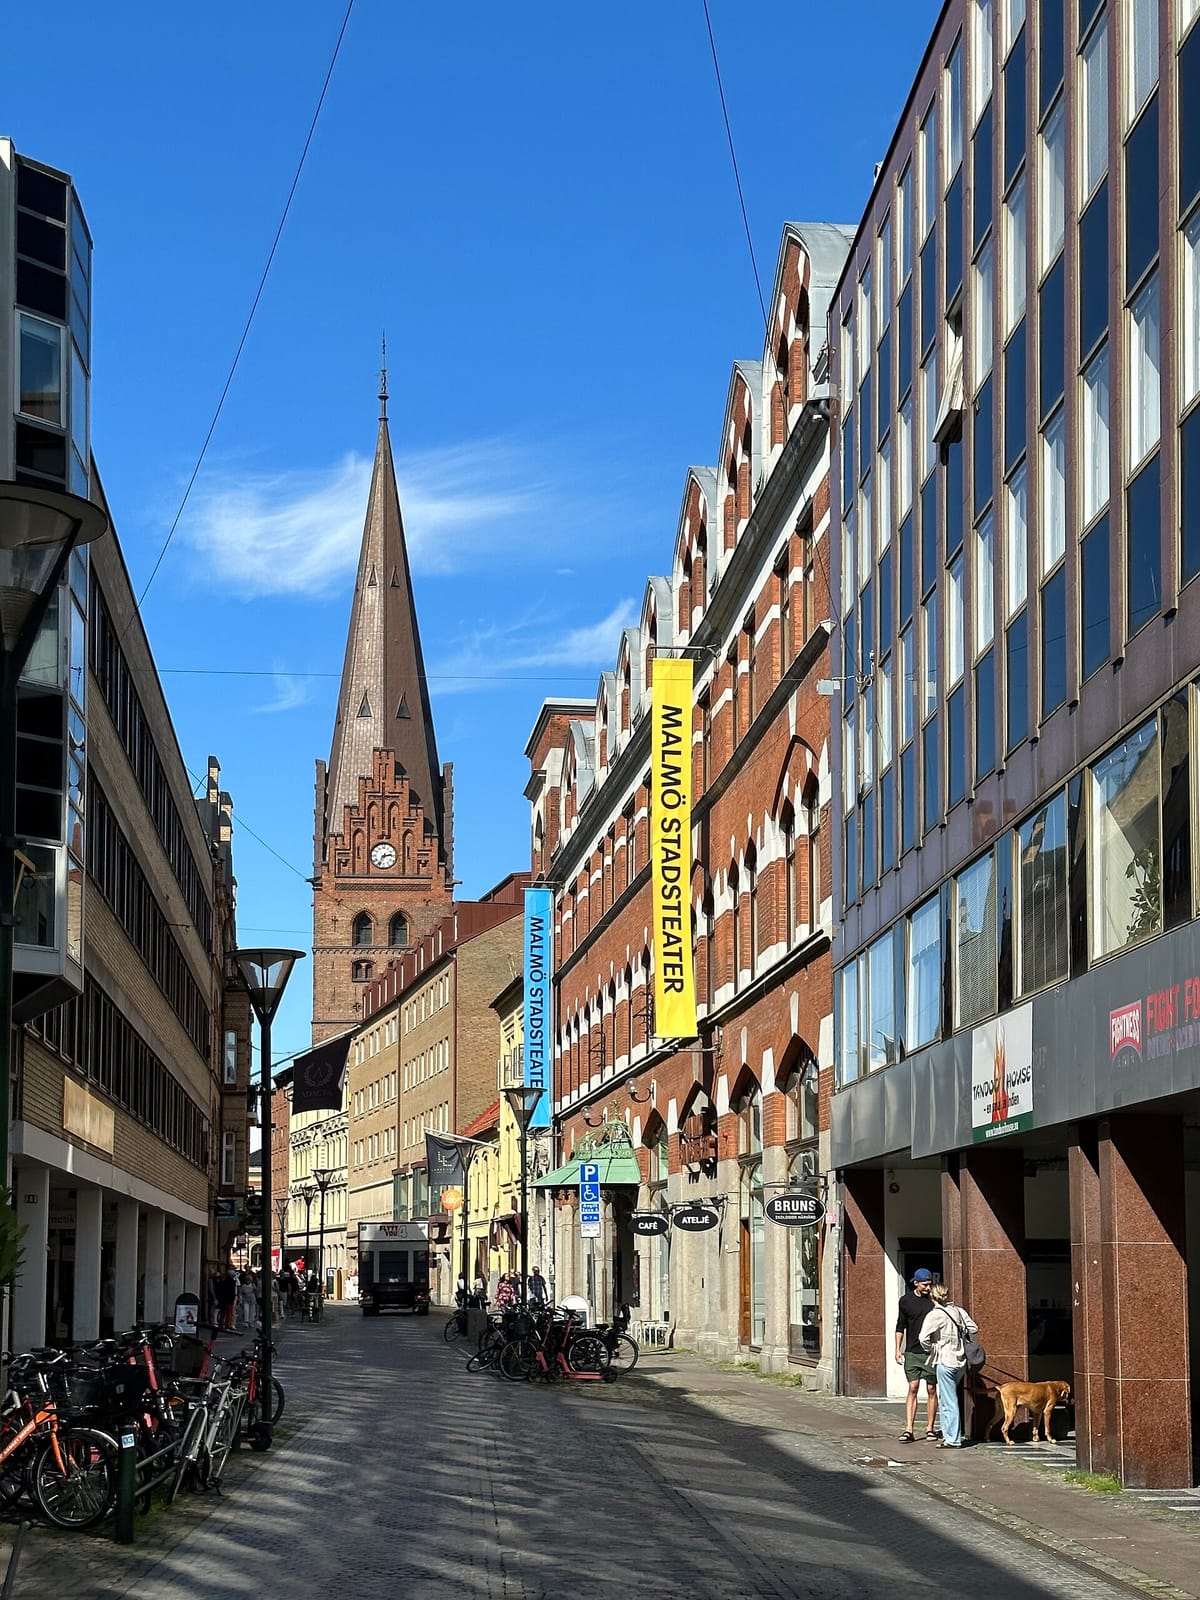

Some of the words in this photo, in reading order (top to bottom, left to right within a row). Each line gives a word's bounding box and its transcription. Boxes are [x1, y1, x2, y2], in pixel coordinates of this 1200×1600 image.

[661, 705, 686, 809] MALMÖ
[661, 817, 684, 994] STADSTEATER
[530, 917, 546, 983] MALMÖ
[1111, 1008, 1140, 1053] FIGHTNESS
[1146, 984, 1180, 1036] FIGHT
[530, 987, 544, 1088] STADSTEATE
[584, 1165, 596, 1182] P
[638, 1221, 658, 1230] CAFÉ
[681, 1215, 710, 1224] ATELJÉ
[774, 1200, 817, 1212] BRUNS
